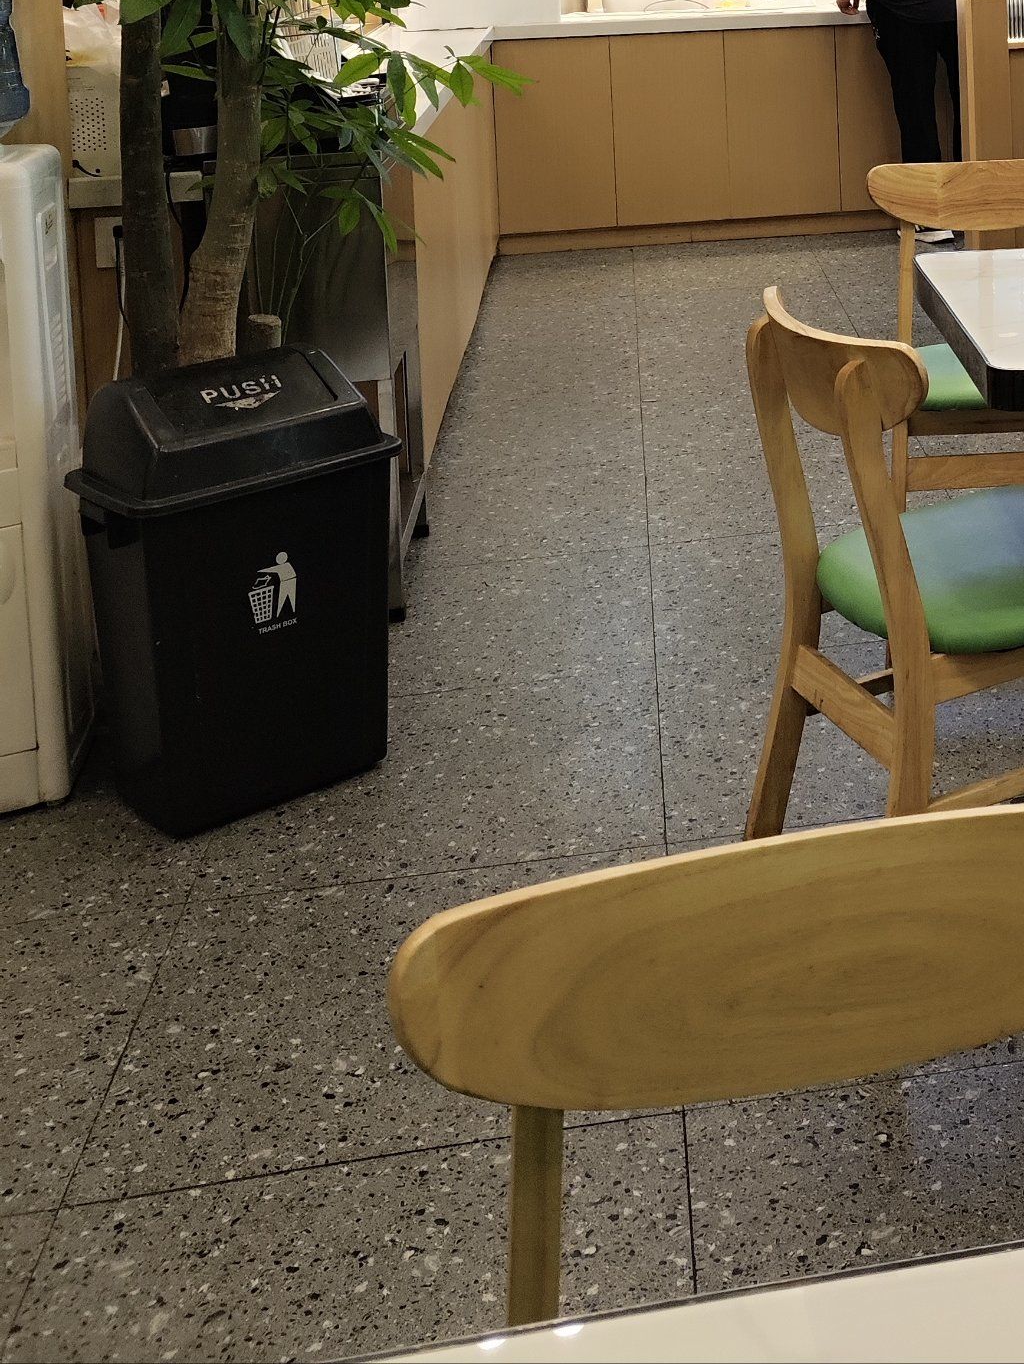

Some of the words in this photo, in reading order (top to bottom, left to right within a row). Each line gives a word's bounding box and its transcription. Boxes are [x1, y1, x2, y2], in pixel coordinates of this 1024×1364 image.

[200, 375, 281, 404] PUSH
[259, 623, 281, 634] TRASH
[283, 617, 298, 627] BOX
